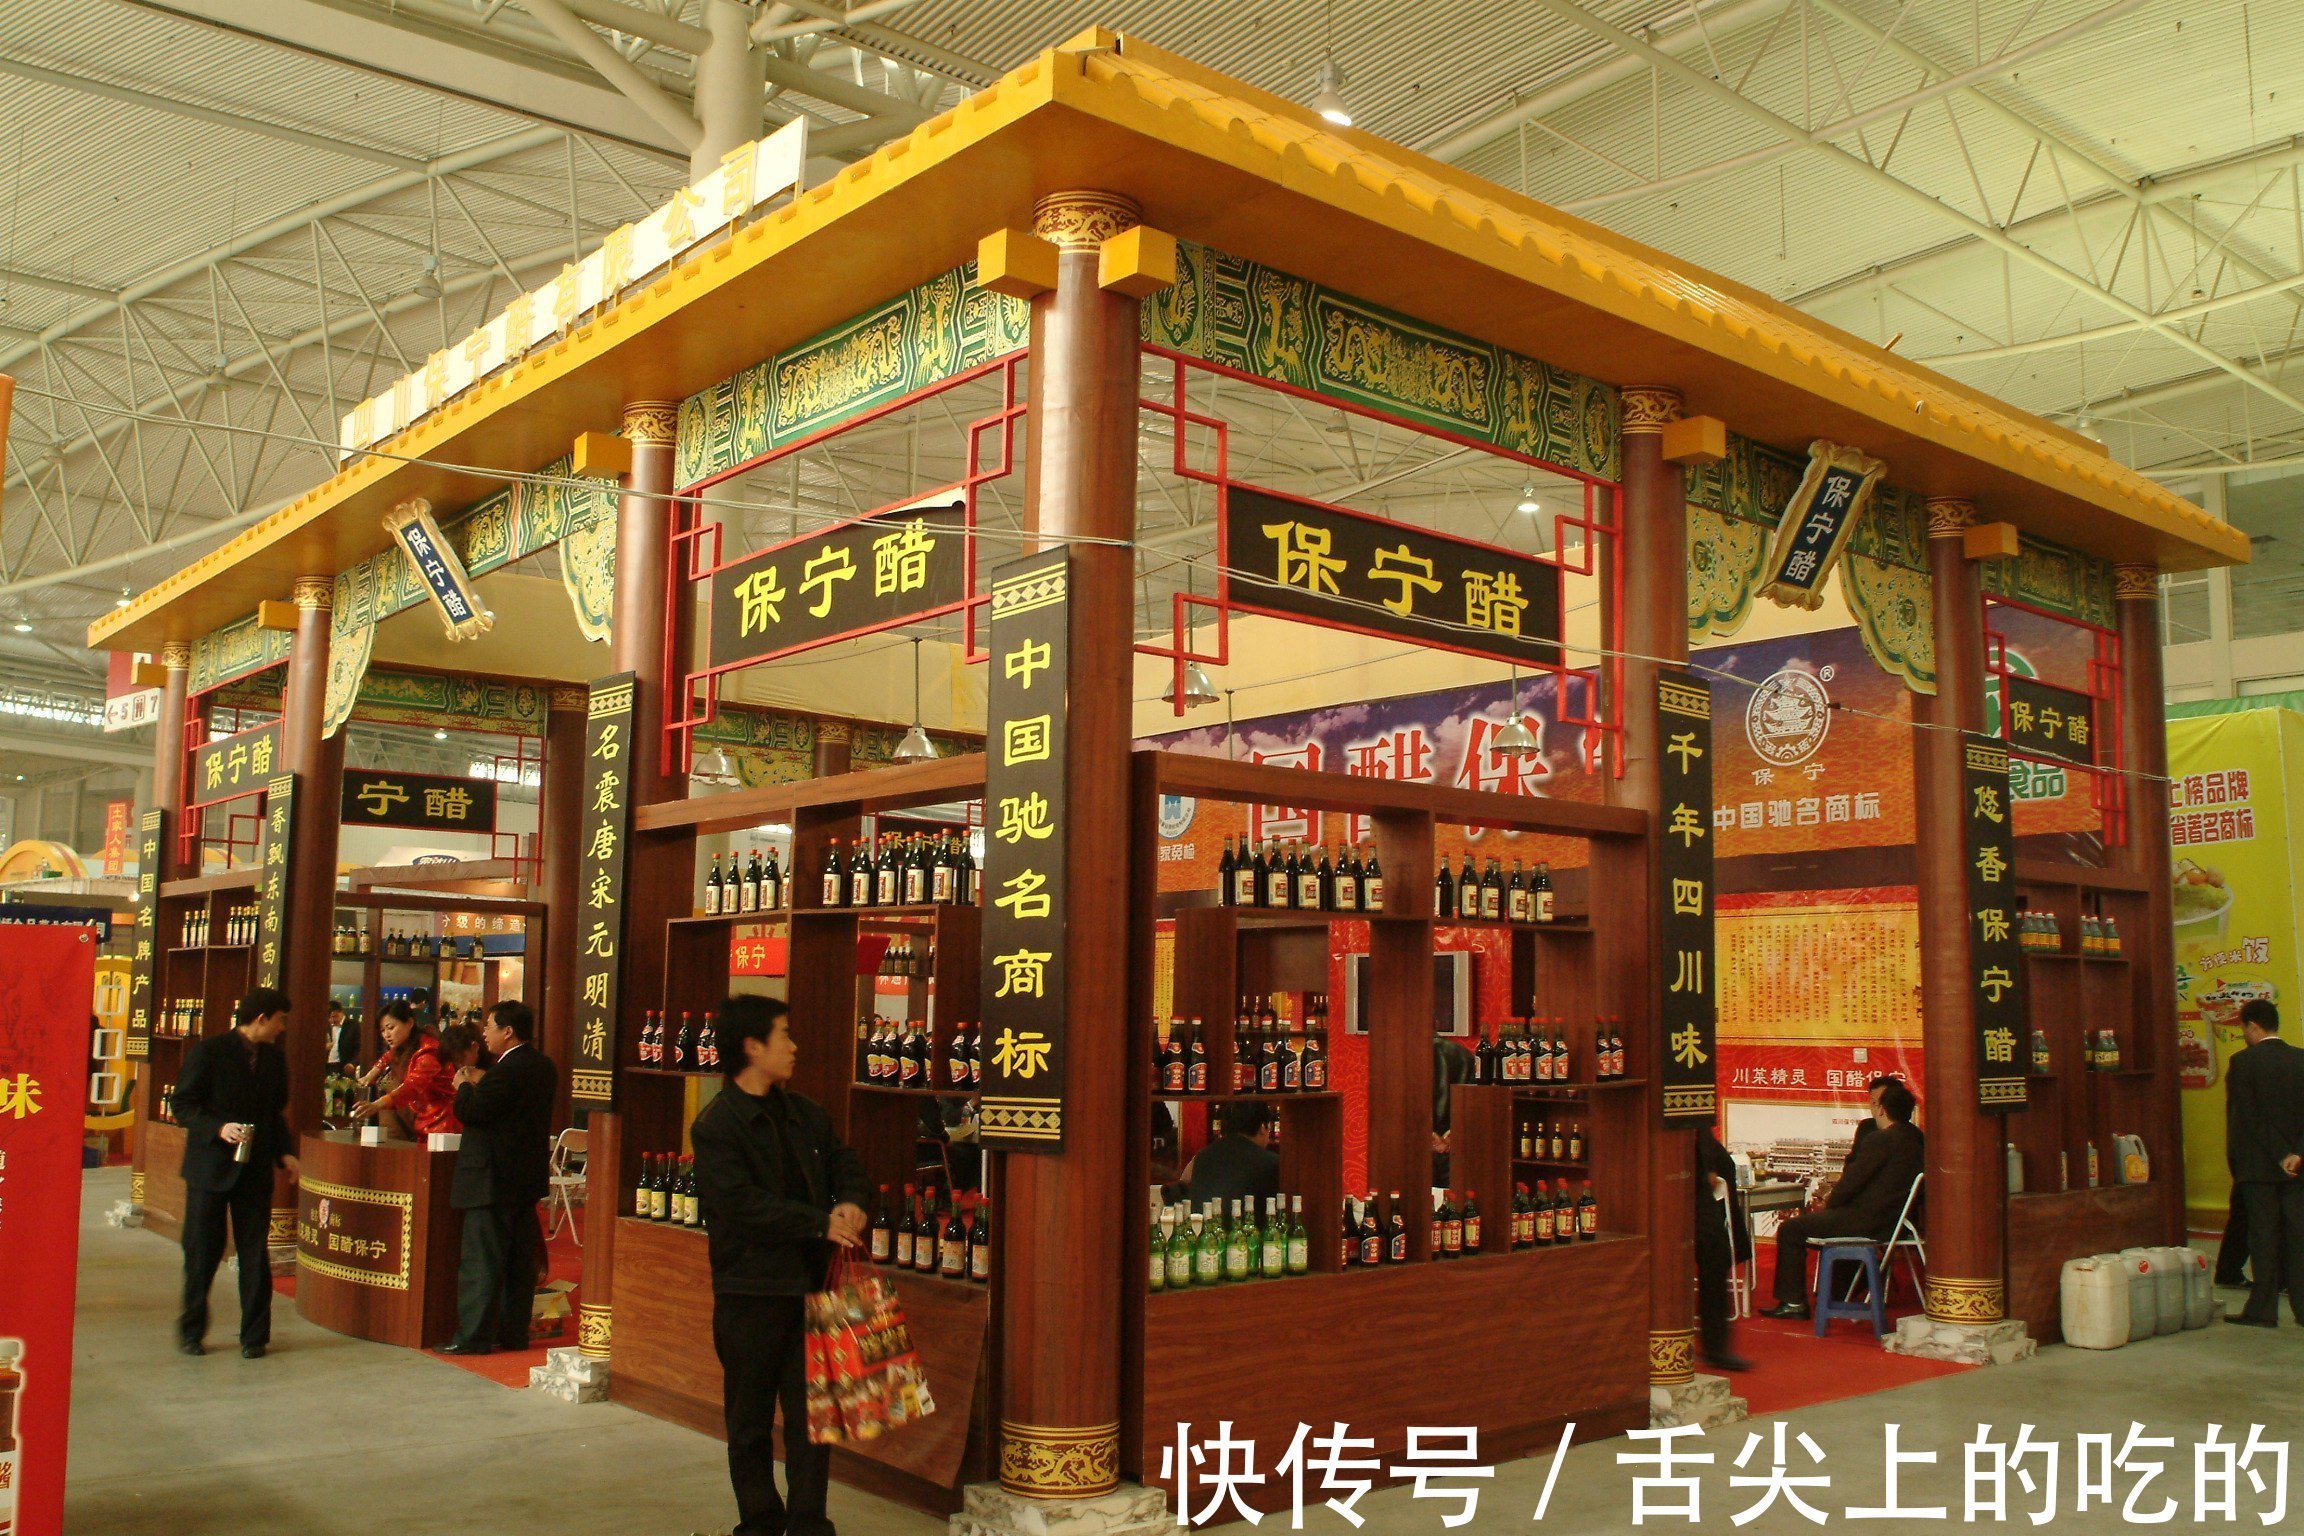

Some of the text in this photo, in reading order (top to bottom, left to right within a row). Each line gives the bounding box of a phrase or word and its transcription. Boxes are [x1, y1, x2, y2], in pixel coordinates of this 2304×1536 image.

[407, 528, 467, 617] 保宁醋
[1785, 475, 1852, 582] 保宁醋
[734, 517, 936, 638] 保宁醋
[1262, 521, 1529, 638] 保宁醋
[206, 734, 273, 790] 保宁醋
[2010, 701, 2089, 745] 保宁醋
[357, 780, 473, 820] 宁醋
[1713, 792, 1880, 831] 中国驰名商标
[1752, 763, 1826, 785] 保宁
[582, 724, 620, 1061] 名震唐宋元明清
[992, 638, 1054, 1079] 中国驰名商标
[1158, 843, 1195, 861] 家免检
[132, 838, 157, 1029] 中国名牌产品
[1667, 732, 1708, 1069] 千年四川味
[1974, 786, 2017, 1062] 悠香保宁醋
[730, 943, 767, 970] 保宁
[328, 1232, 387, 1259] 国醋保宁
